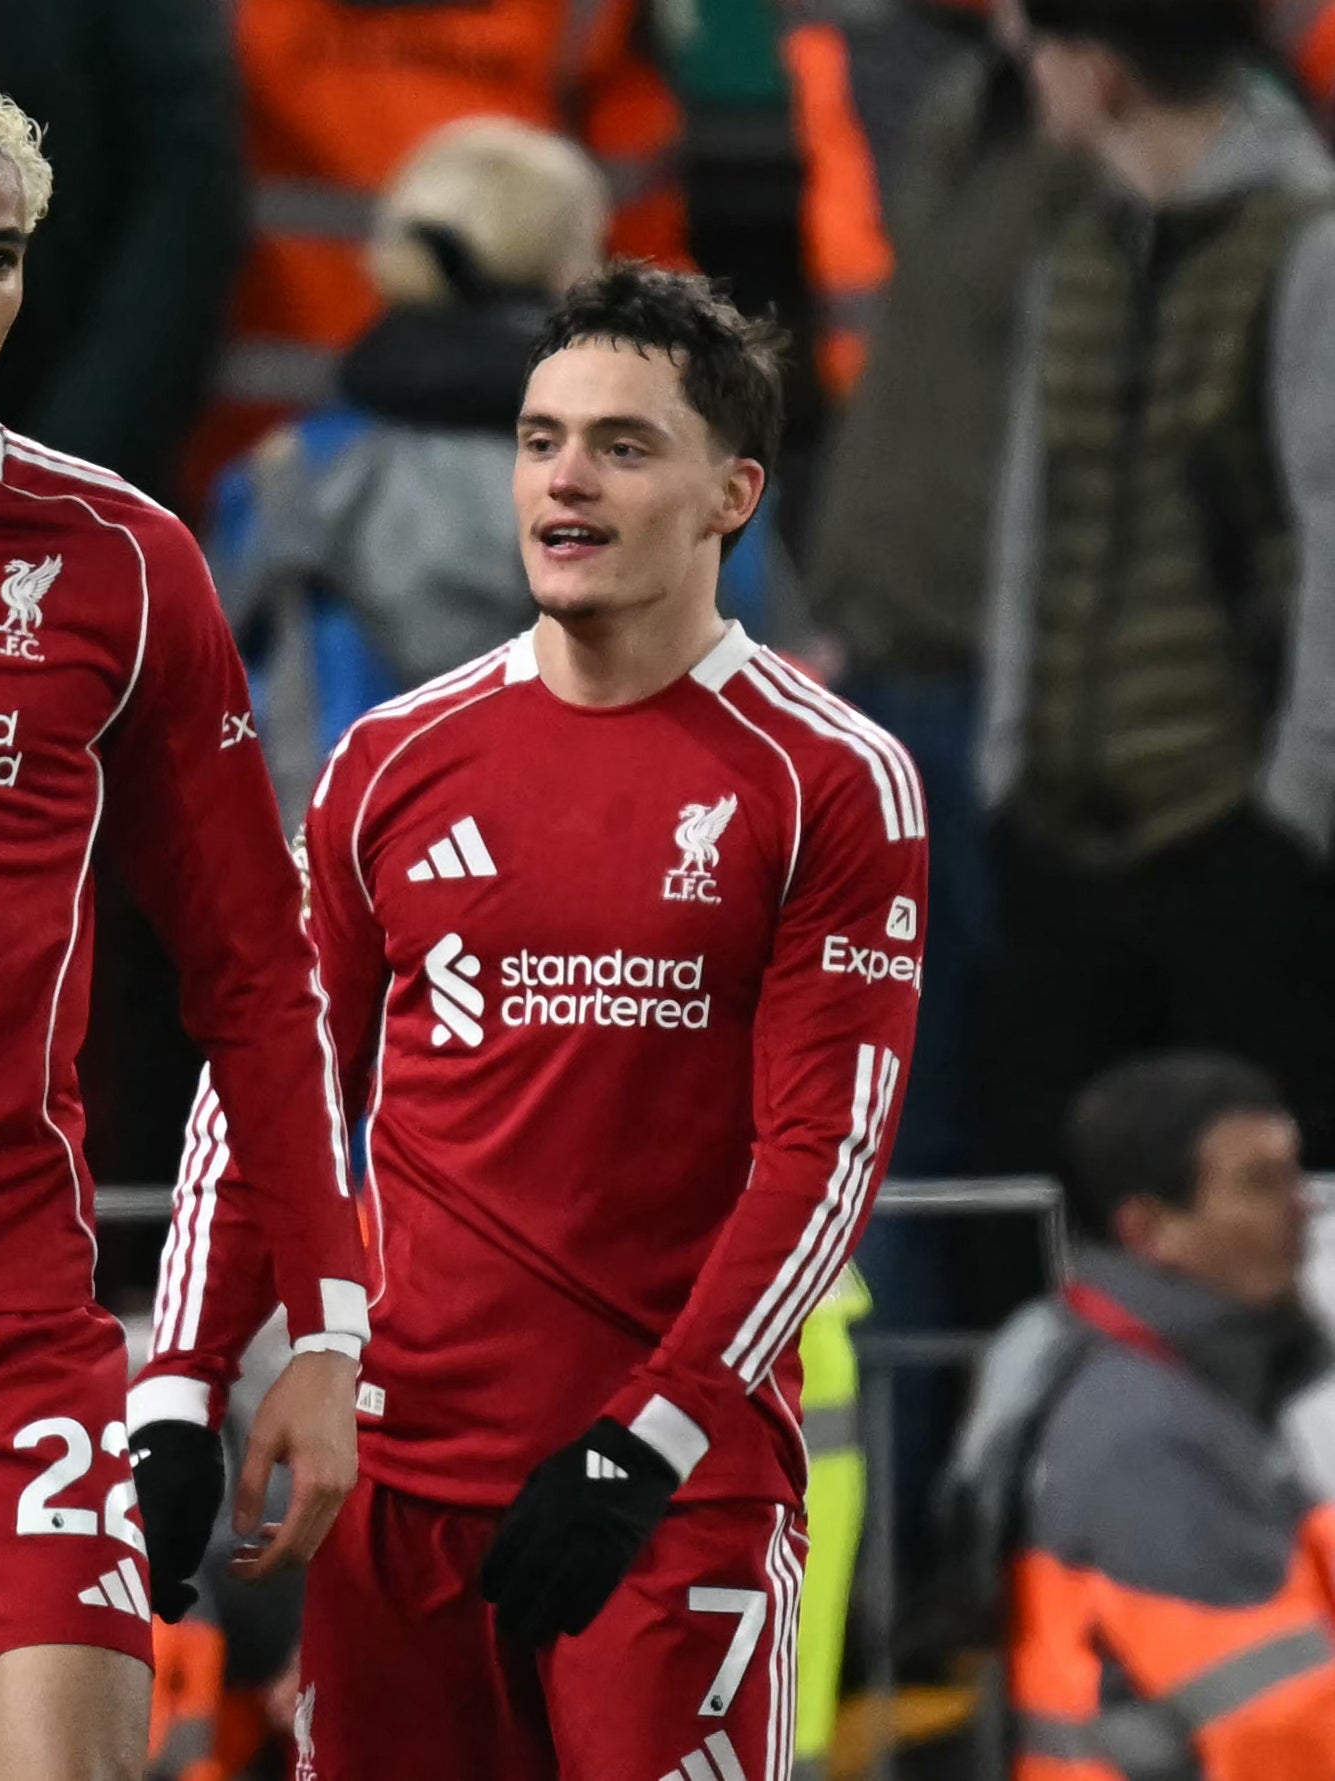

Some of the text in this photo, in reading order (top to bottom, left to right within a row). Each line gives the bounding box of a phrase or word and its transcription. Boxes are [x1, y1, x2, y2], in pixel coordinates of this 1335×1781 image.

[663, 876, 722, 904] L.F.C.
[500, 948, 704, 991] standard
[501, 988, 711, 1030] chartered
[688, 1585, 767, 1717] 7
